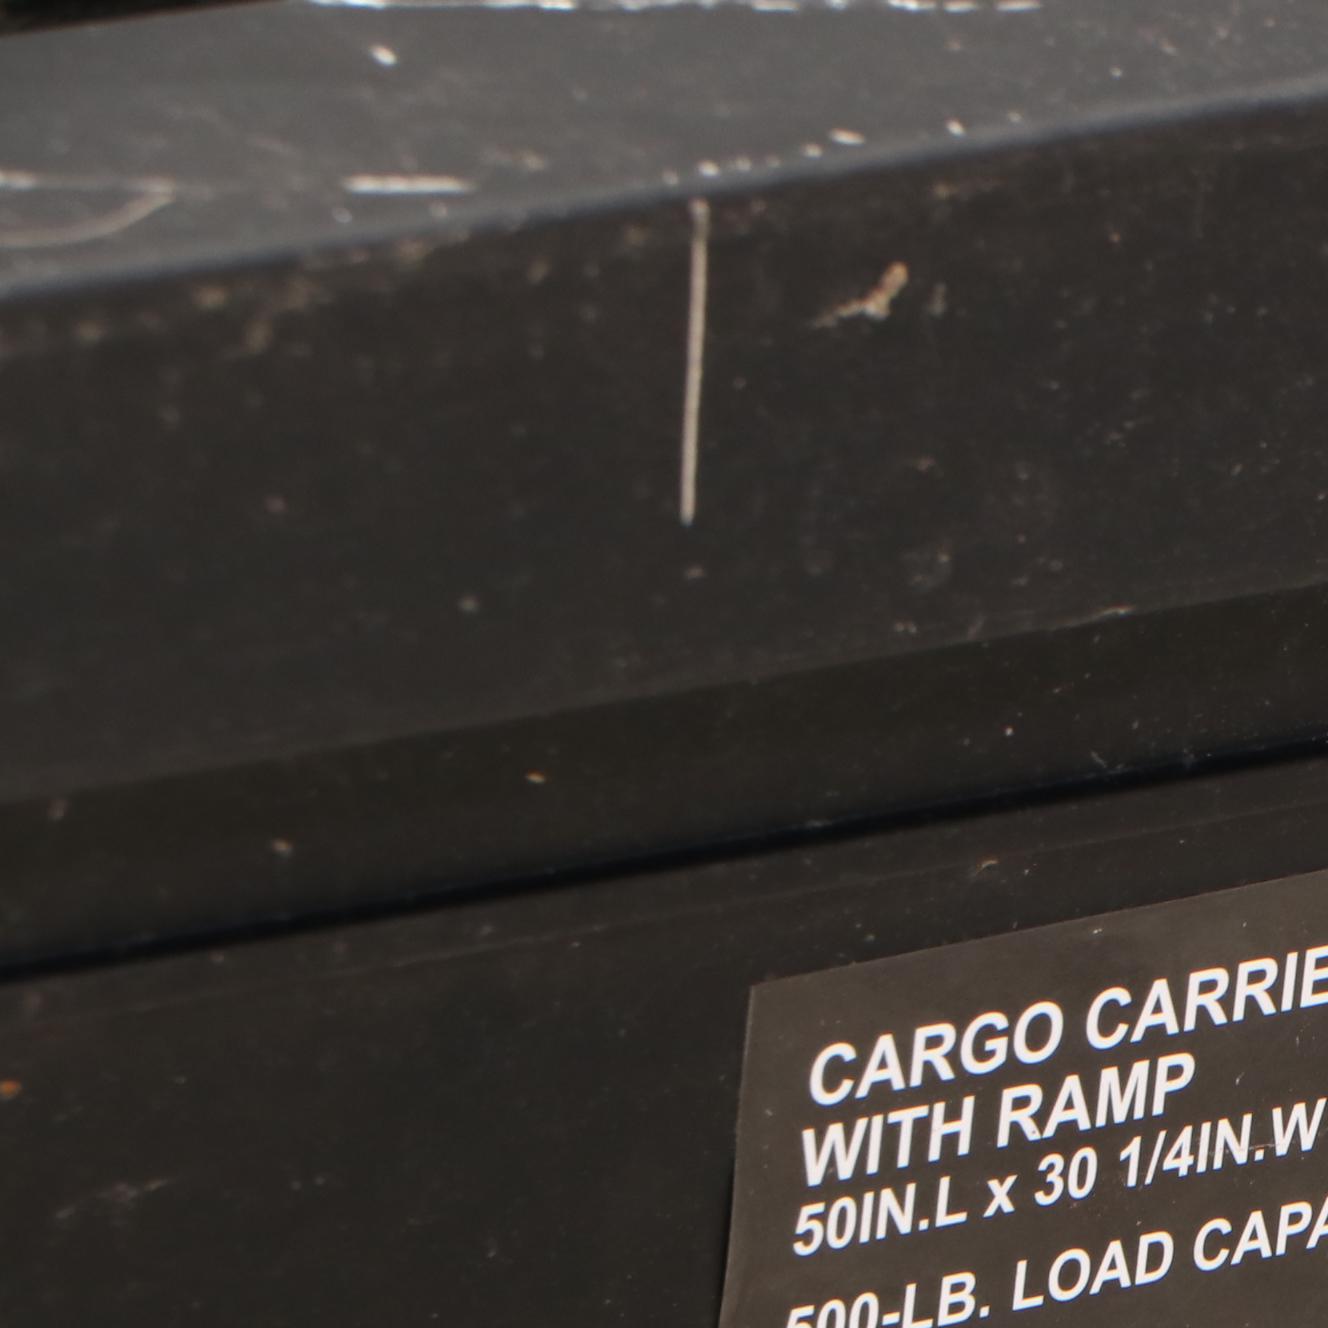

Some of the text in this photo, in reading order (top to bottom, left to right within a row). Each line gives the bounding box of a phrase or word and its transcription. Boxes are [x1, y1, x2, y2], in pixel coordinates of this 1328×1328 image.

[809, 1001, 1064, 1106] CARGO
[793, 1097, 1327, 1256] 50IN.L x 30 1/4IN.W
[801, 1052, 1196, 1187] WITH RAMP
[1012, 1231, 1174, 1311] LOAD
